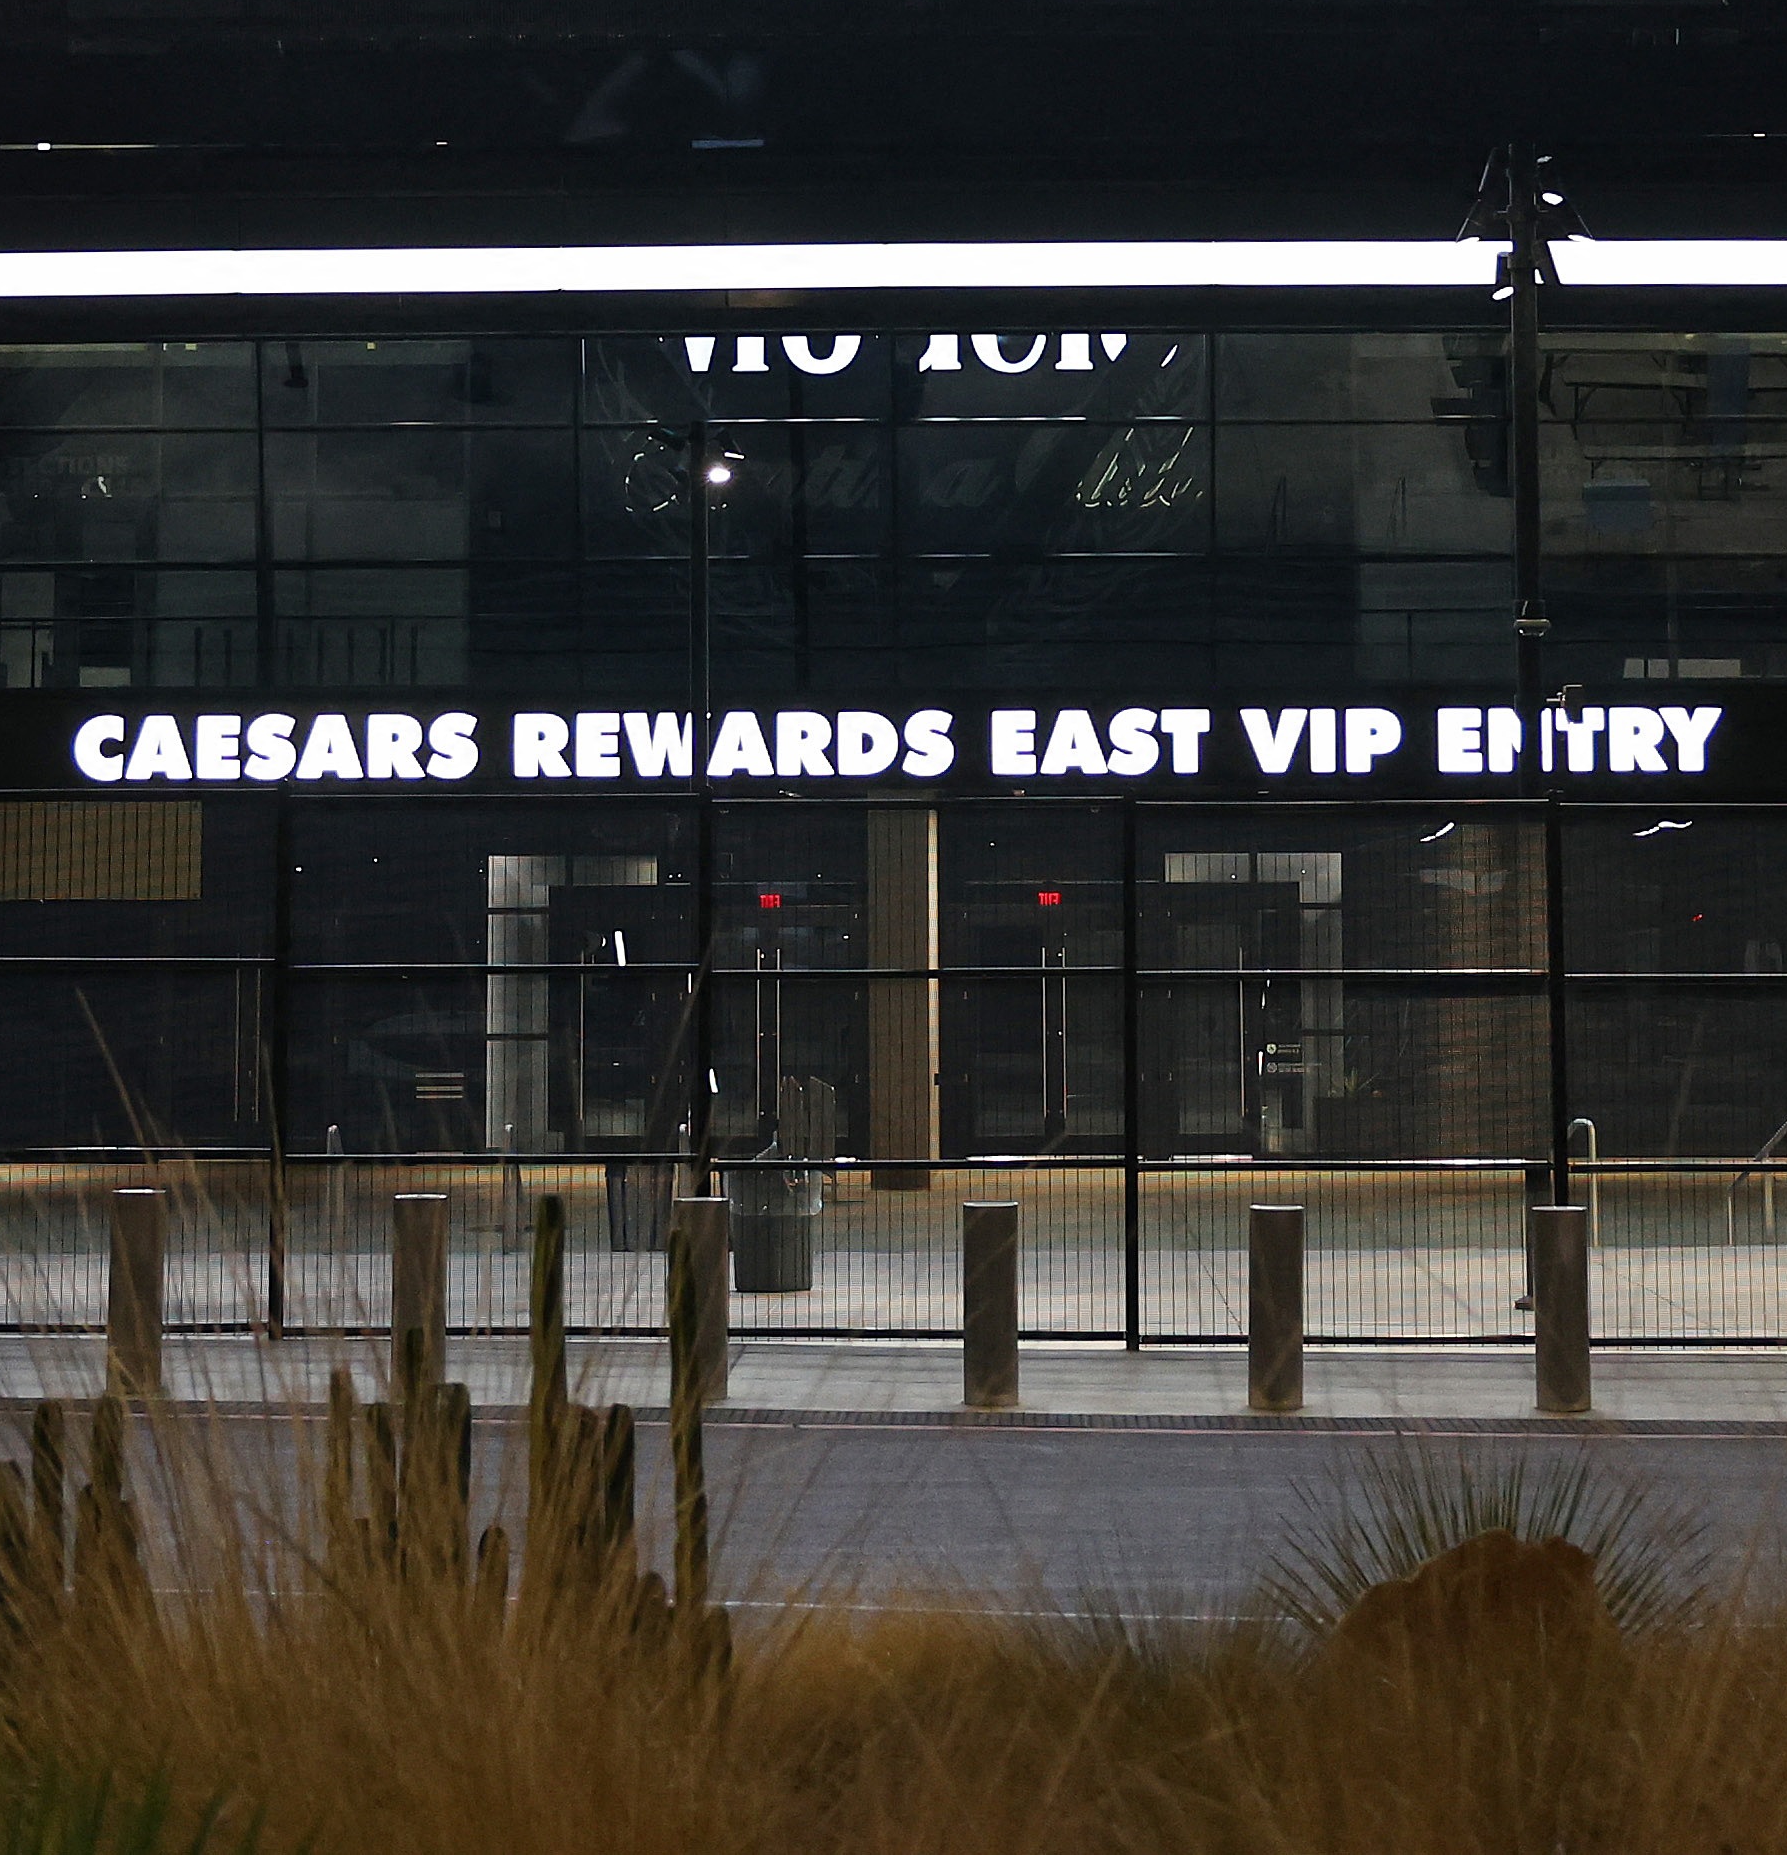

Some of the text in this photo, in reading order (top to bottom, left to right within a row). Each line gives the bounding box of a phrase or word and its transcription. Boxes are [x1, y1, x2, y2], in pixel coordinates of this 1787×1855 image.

[73, 706, 1723, 783] CAESARS REWARDS EAST VIP ENTRY
